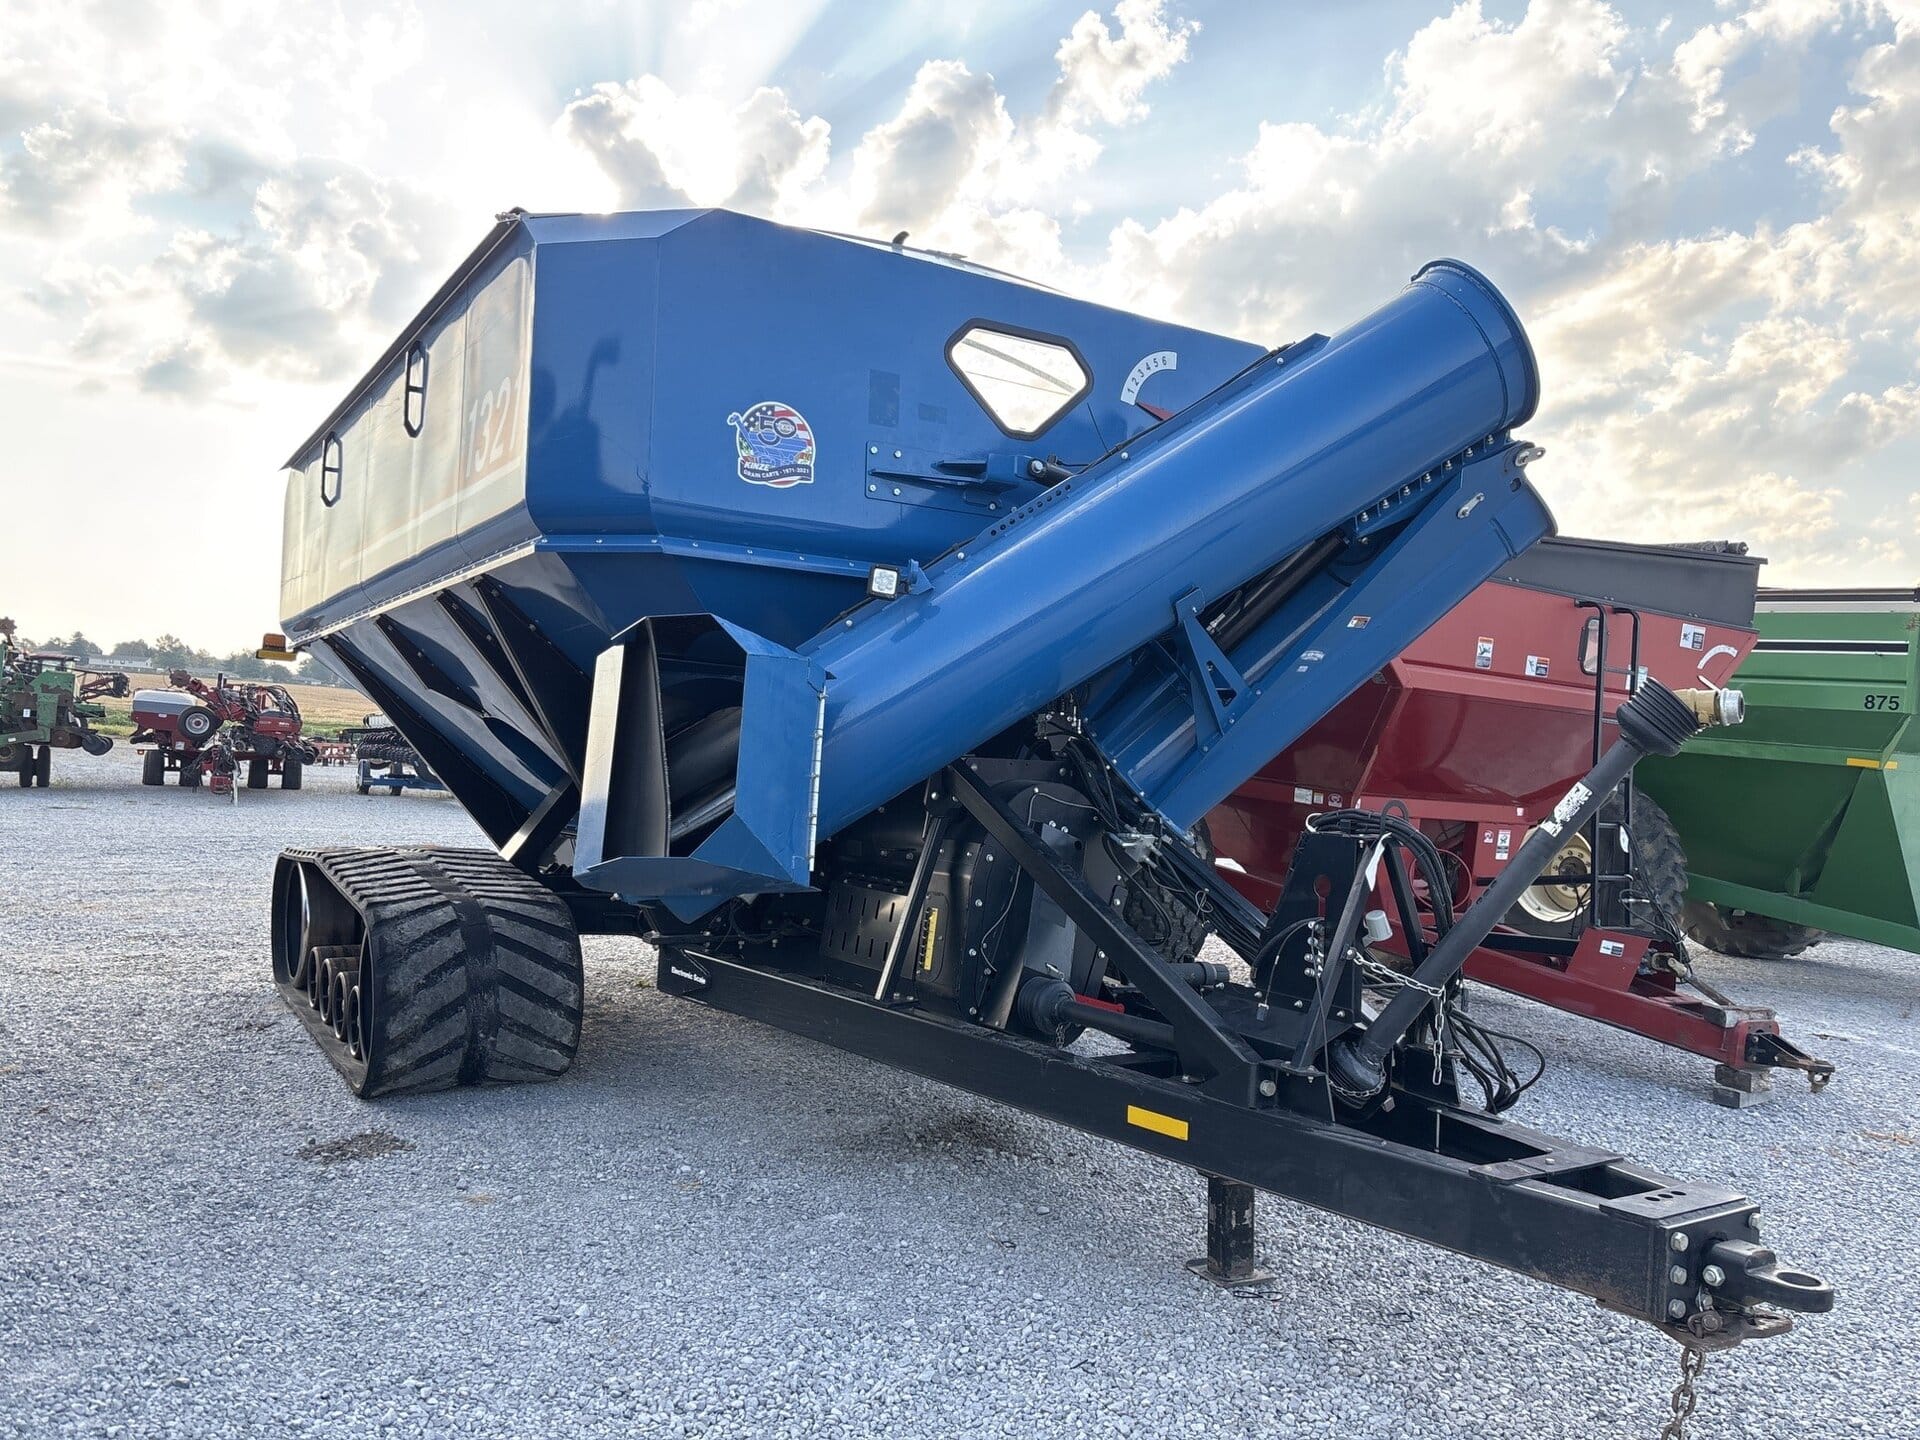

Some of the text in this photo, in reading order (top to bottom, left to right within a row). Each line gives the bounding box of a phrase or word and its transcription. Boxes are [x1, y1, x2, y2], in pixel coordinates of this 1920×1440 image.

[1131, 377, 1139, 386] 2
[1137, 368, 1145, 378] 3
[1145, 362, 1151, 371] 4
[1153, 358, 1159, 367] 5
[1161, 356, 1167, 366] 6
[466, 364, 524, 478] 1321
[743, 461, 770, 472] KINZE
[743, 469, 761, 478] GRAIN
[1864, 694, 1900, 711] 875
[671, 966, 706, 985] Electronic Scale
